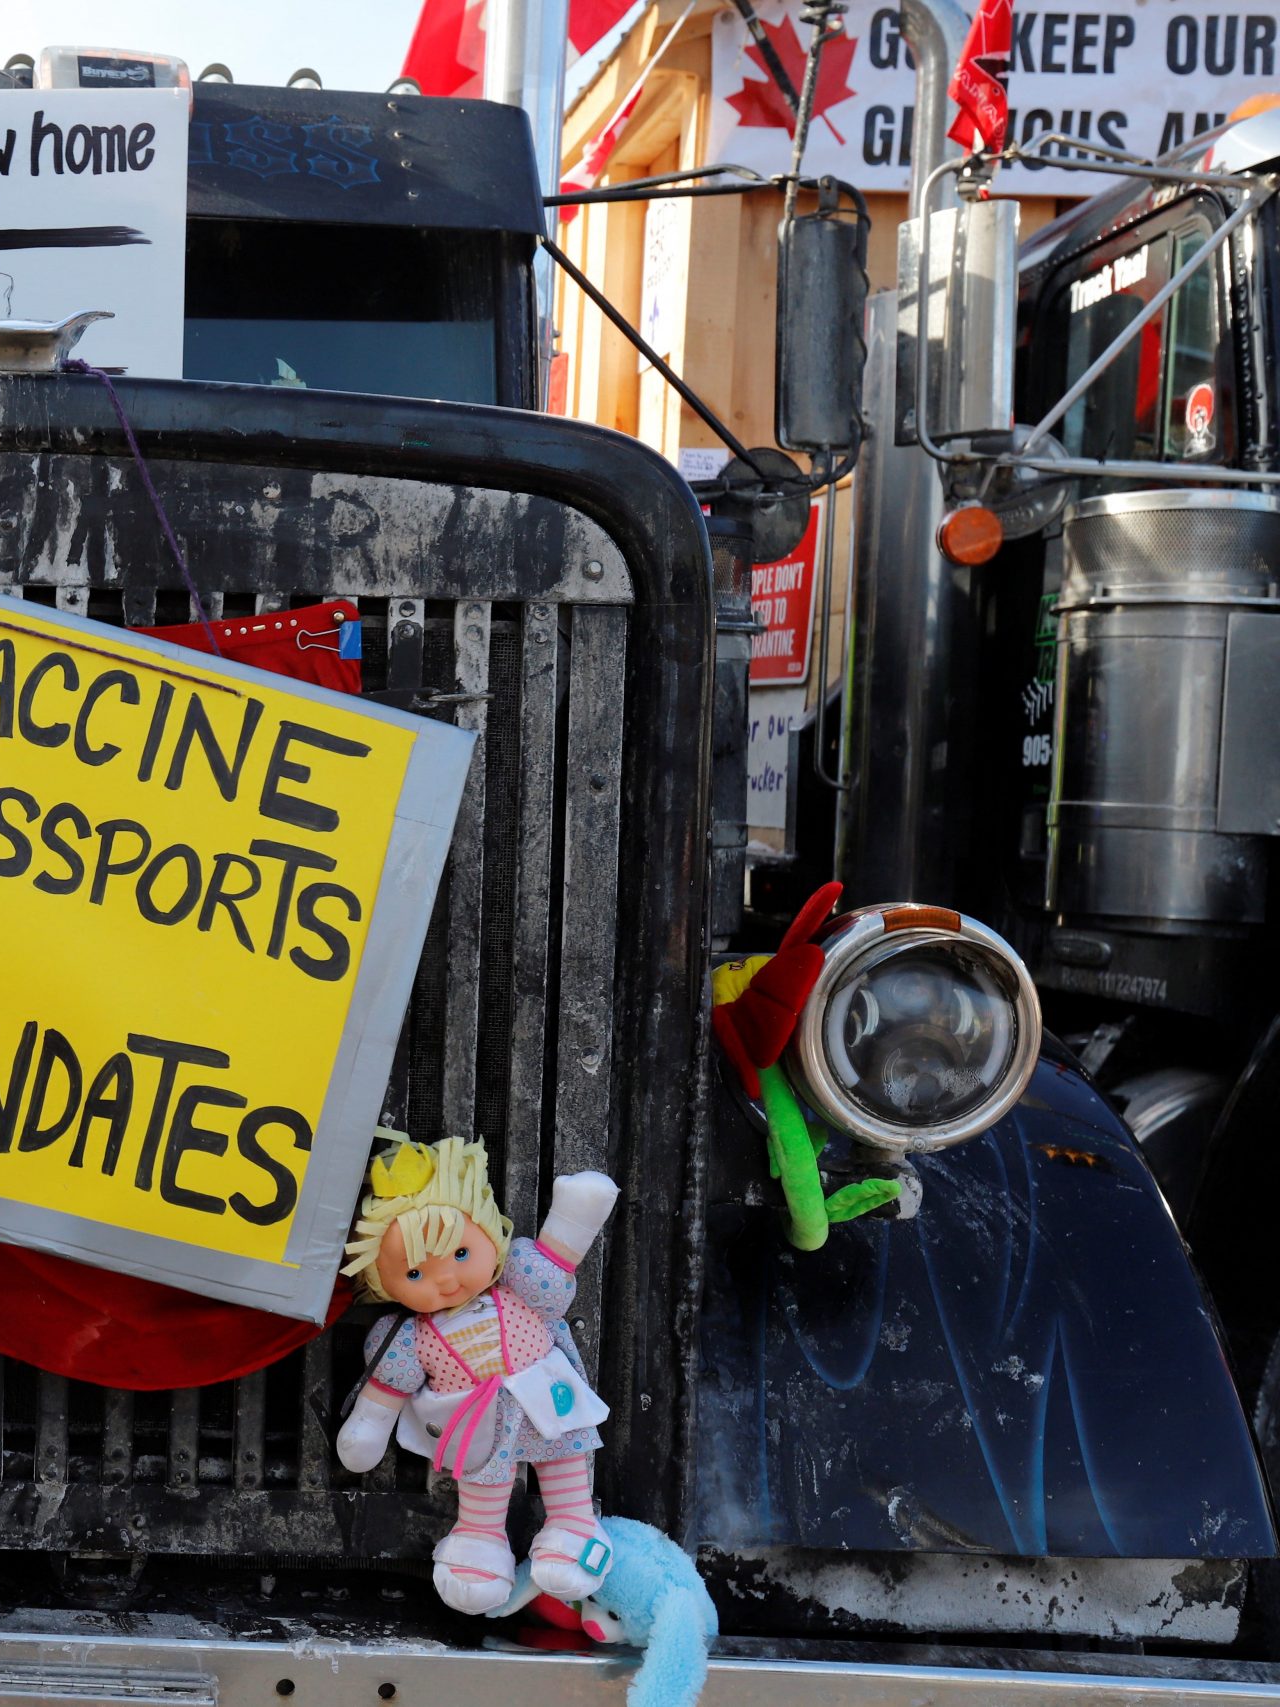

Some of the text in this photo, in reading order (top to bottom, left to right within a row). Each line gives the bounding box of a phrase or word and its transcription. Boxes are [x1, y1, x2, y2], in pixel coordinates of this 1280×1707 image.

[1007, 13, 1278, 76] KEEP OUR
[30, 110, 156, 176] home
[751, 568, 774, 596] OPLE
[774, 597, 788, 625] TO
[751, 629, 796, 658] RANTINE
